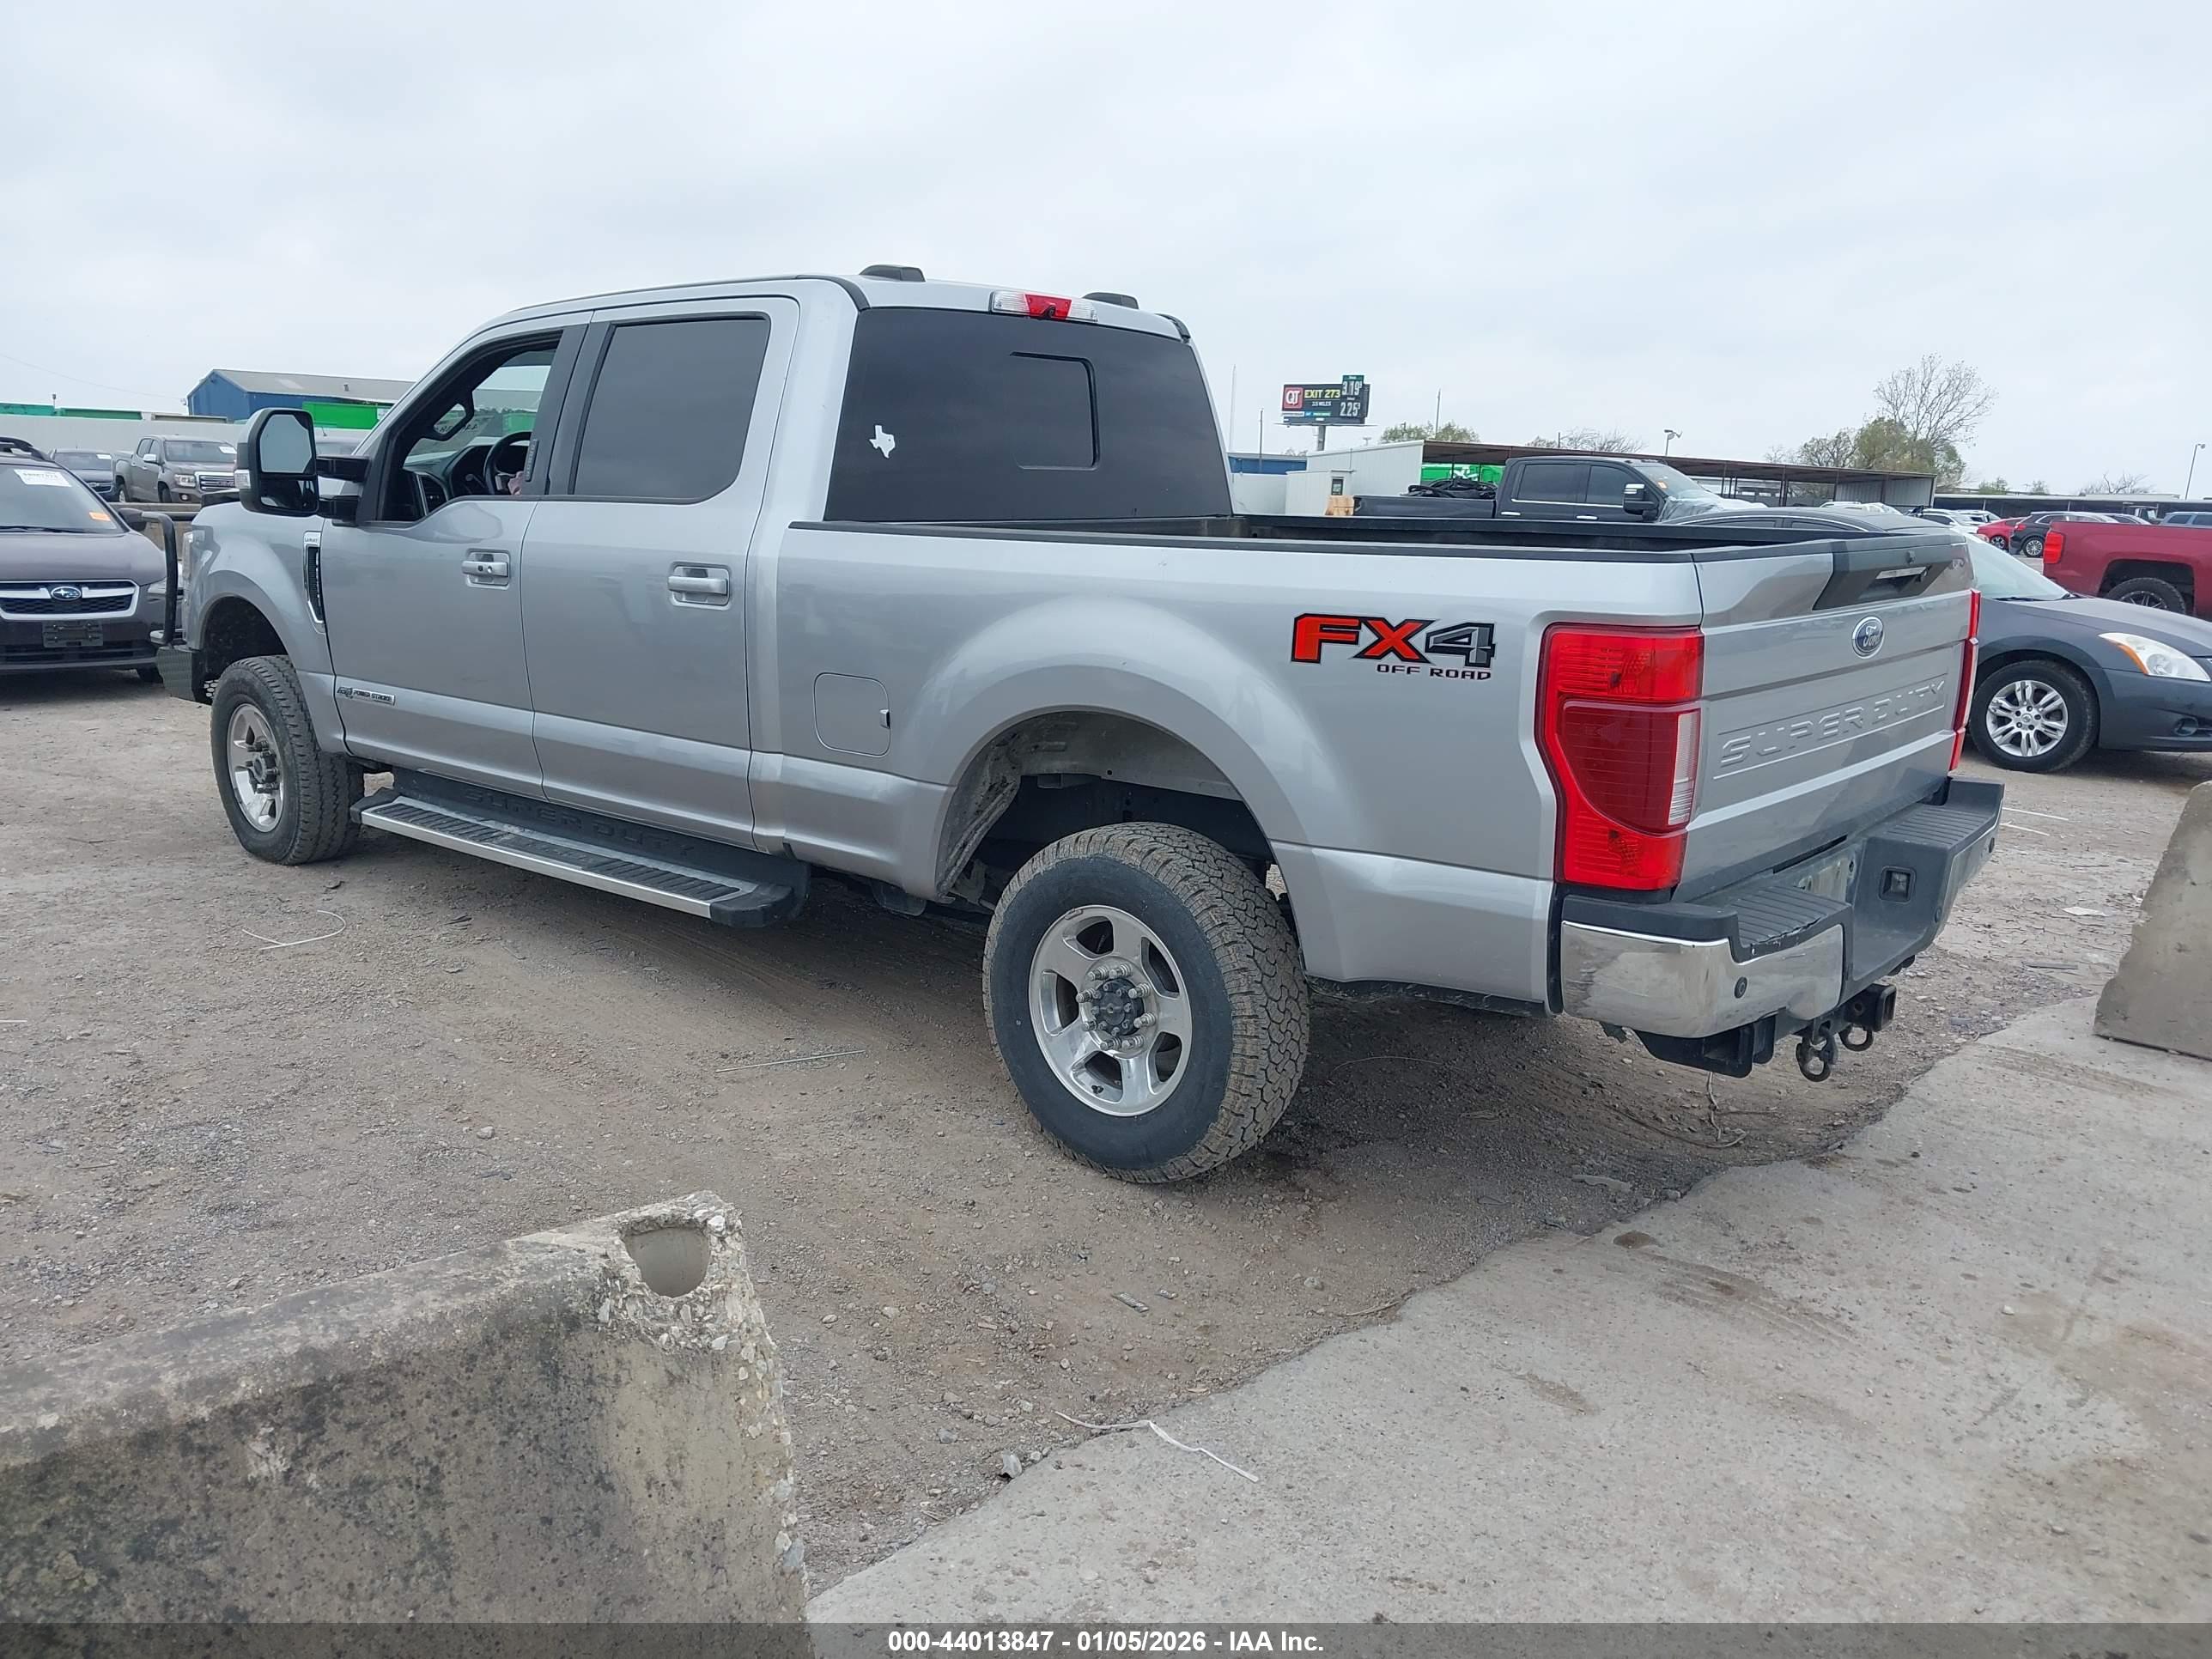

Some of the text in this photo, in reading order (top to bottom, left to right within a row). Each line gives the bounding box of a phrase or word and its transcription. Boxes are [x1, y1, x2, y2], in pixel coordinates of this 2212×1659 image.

[1285, 390, 1300, 405] QT
[1304, 389, 1340, 398] EXIT 273
[1291, 613, 1496, 668] FX4
[1376, 664, 1492, 680] OFF ROAD
[1719, 679, 1947, 768] SUPER DUTY
[465, 787, 582, 830] SUPER
[592, 819, 695, 856] DUTY
